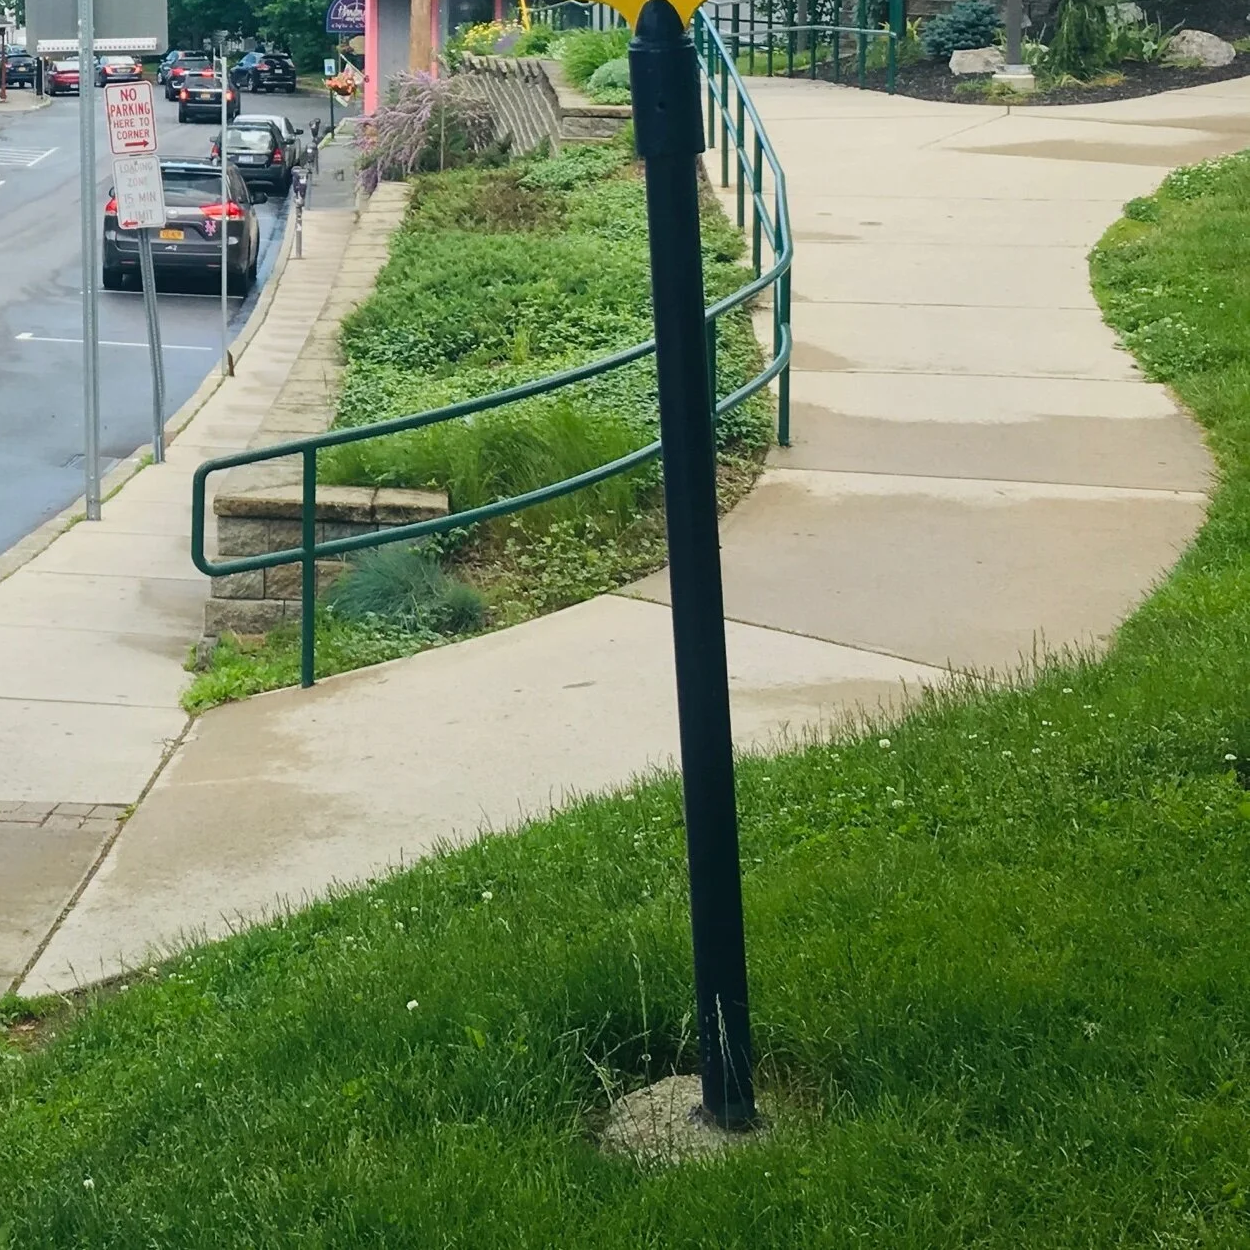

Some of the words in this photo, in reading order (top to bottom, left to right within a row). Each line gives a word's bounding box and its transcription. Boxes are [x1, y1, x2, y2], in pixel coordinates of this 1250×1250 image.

[120, 88, 137, 101] NO
[110, 102, 150, 117] PARKING
[113, 118, 135, 129] HERE
[139, 117, 150, 127] TO
[116, 129, 150, 140] CORNER
[119, 161, 153, 175] LOADING
[127, 177, 148, 187] ZONE
[124, 194, 134, 204] 15
[138, 191, 156, 203] MIN
[129, 209, 154, 222] LIMIT
